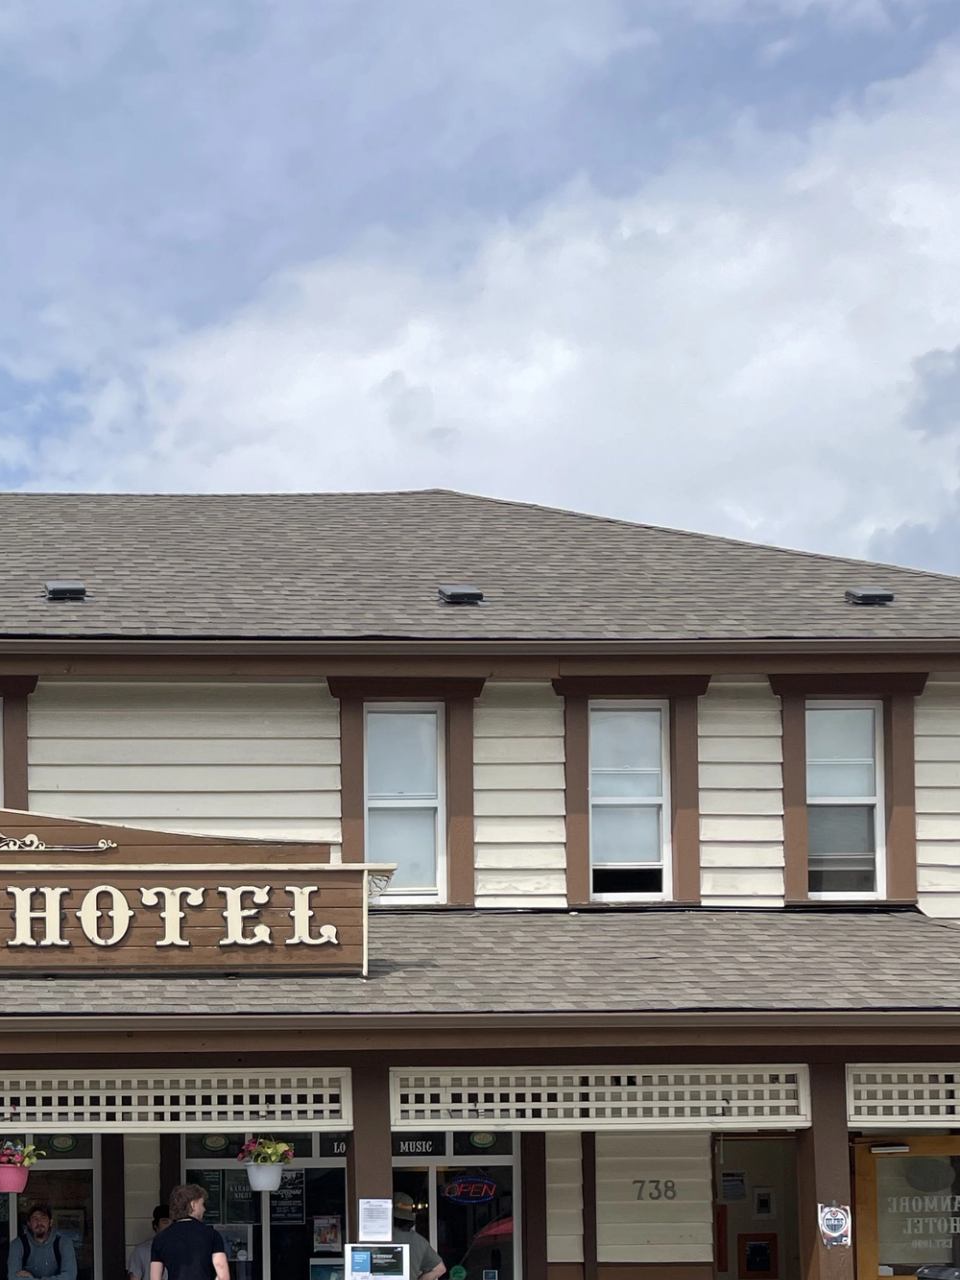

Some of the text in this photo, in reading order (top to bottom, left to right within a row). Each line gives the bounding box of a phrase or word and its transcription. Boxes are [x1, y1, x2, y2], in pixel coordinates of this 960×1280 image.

[6, 884, 339, 947] HOTEL
[400, 1141, 433, 1152] MUSIC
[444, 1184, 497, 1197] OPEN
[632, 1179, 677, 1200] 738
